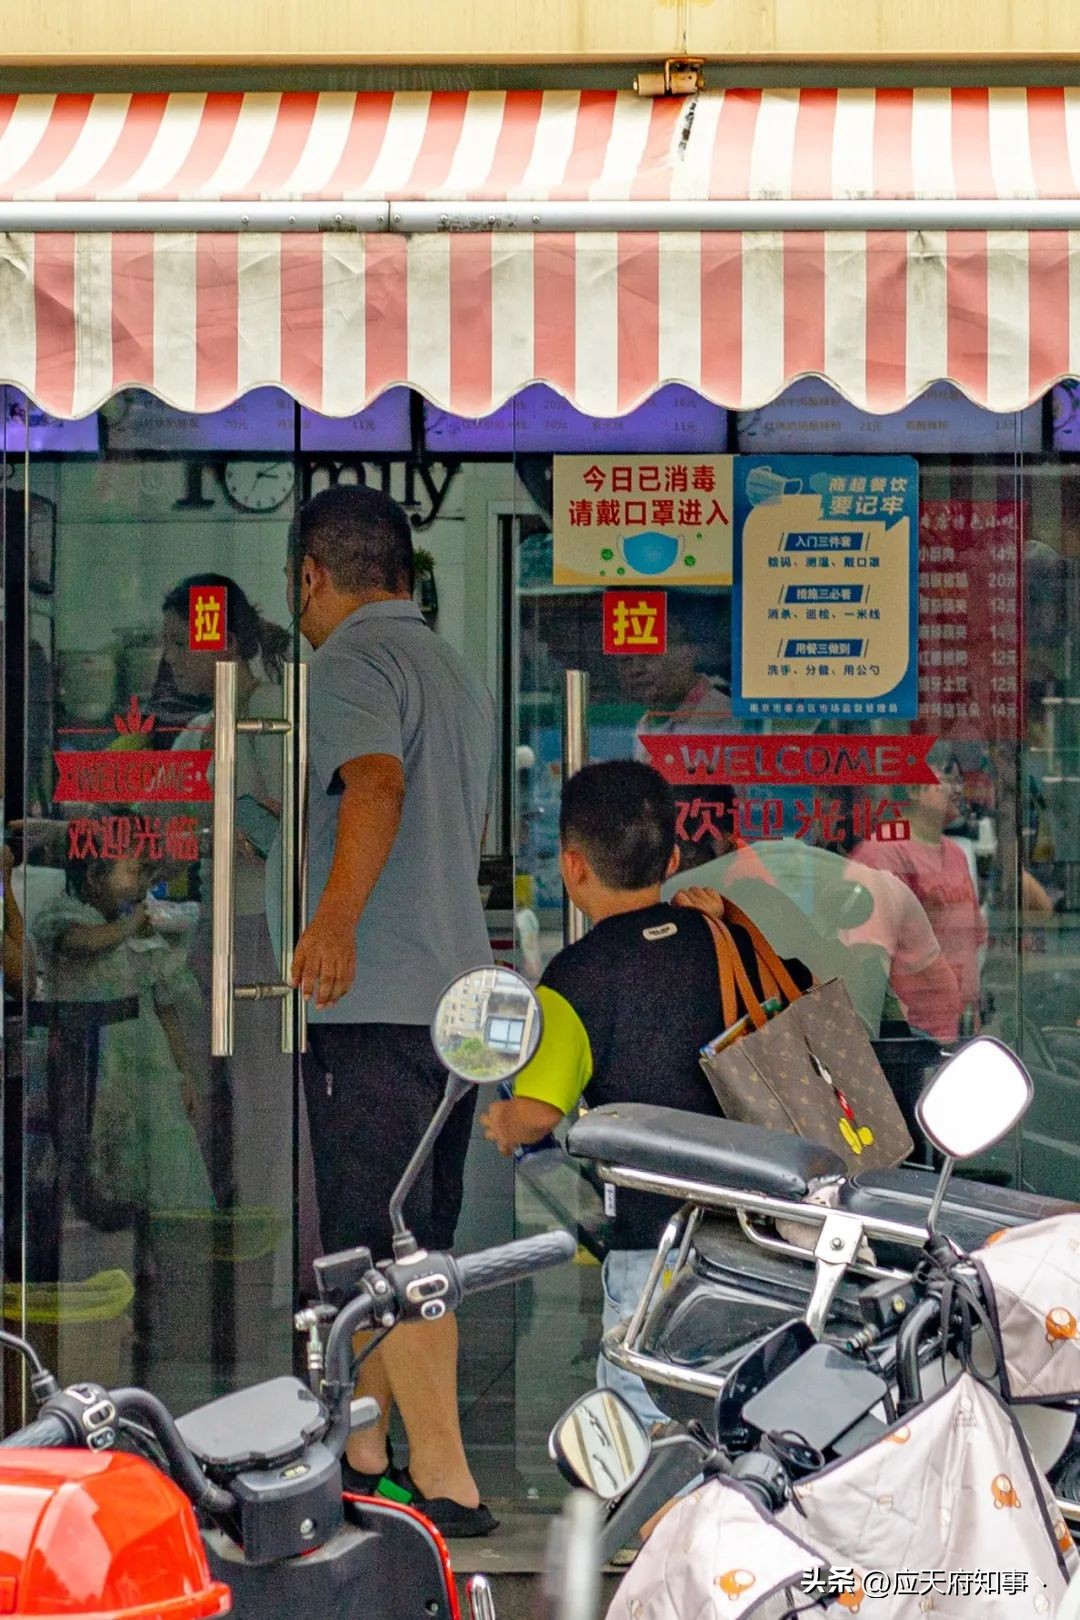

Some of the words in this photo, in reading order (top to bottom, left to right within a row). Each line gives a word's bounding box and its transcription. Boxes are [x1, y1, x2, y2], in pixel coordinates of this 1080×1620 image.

[583, 465, 716, 492] 今日已消毒
[829, 476, 908, 493] 商超餐饮
[569, 499, 729, 526] 请戴口罩进入
[829, 495, 905, 515] 要记牢
[195, 595, 220, 642] 拉
[613, 600, 658, 646] 拉
[678, 745, 901, 776] WELCOME
[76, 761, 194, 793] WELCOME
[673, 799, 912, 843] 欢迎光临
[68, 815, 200, 861] 欢迎光临
